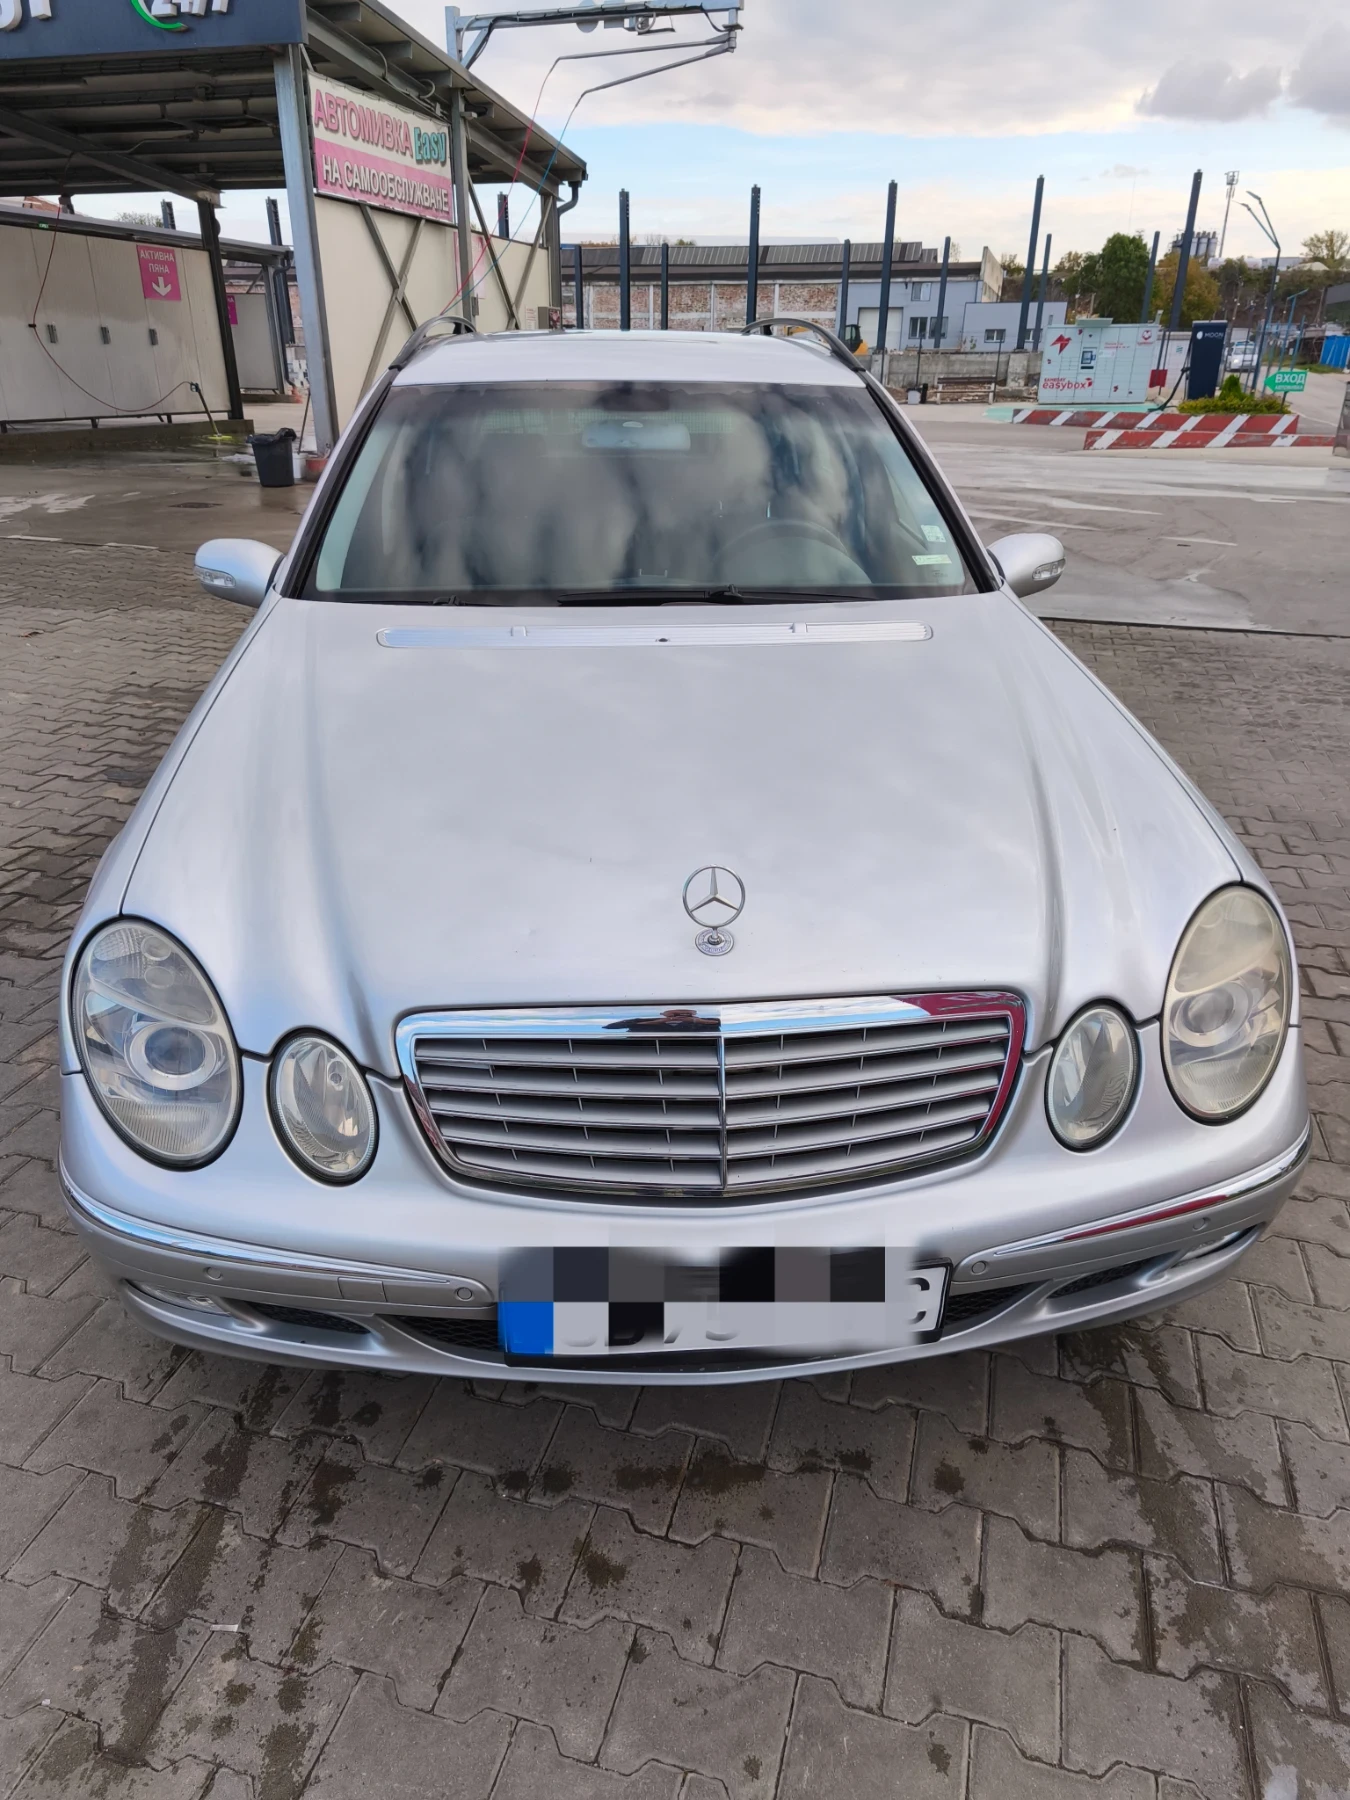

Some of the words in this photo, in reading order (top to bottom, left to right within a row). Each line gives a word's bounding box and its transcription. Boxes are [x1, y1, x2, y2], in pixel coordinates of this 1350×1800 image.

[314, 89, 413, 159] АВТОМИВКА
[413, 127, 447, 163] Easy
[322, 154, 342, 185] НА
[343, 160, 449, 211] САМООБСЛУЖВАНЕ
[140, 250, 175, 262] АКТИВНА
[148, 263, 170, 274] ПЯНА
[1042, 379, 1086, 391] easybox
[1275, 373, 1306, 385] ВХОД
